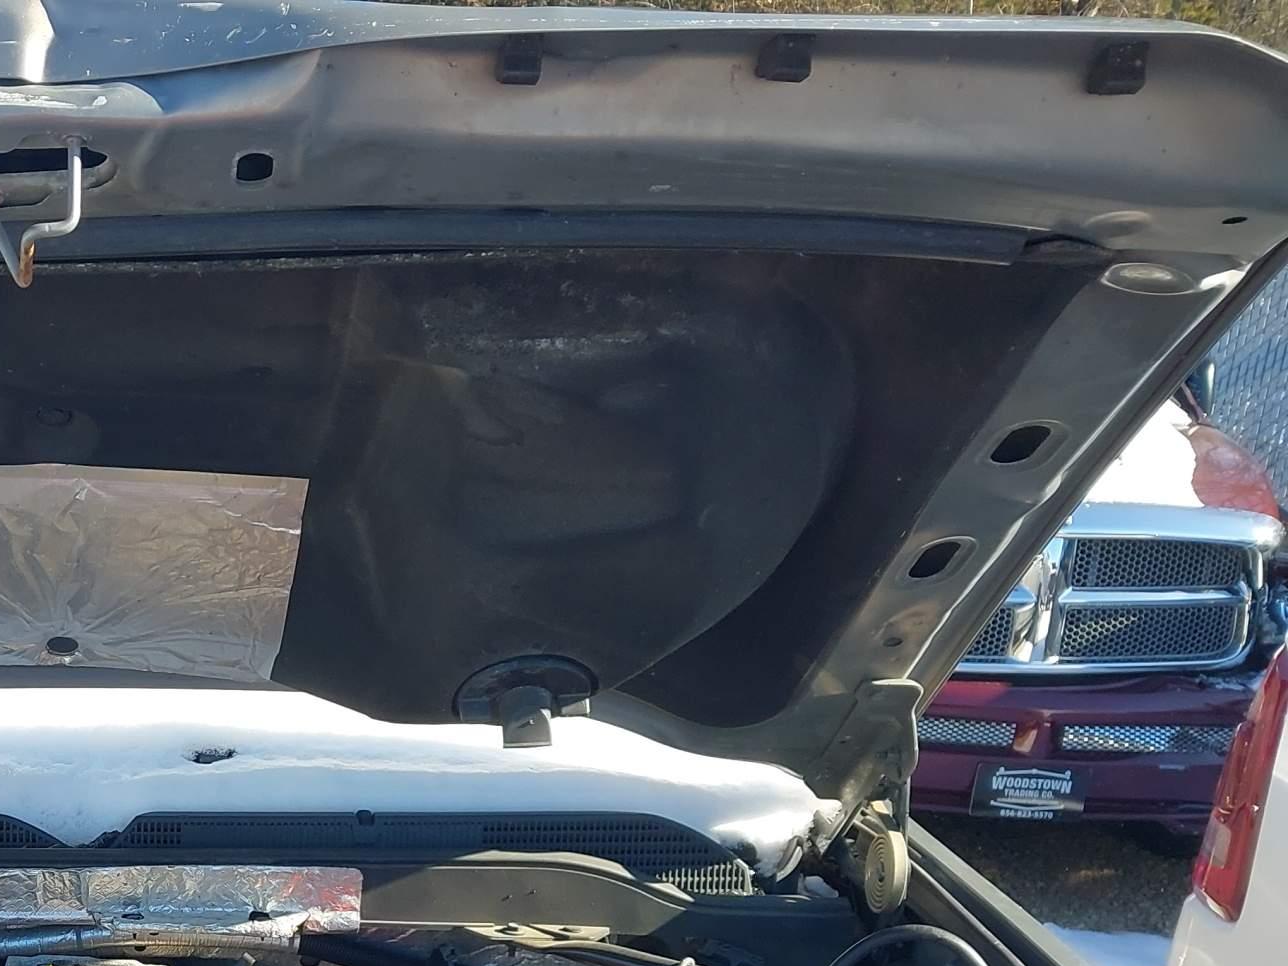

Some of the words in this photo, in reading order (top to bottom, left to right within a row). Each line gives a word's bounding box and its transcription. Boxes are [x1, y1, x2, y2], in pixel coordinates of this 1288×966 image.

[992, 775, 1072, 794] WOODSTOWN
[1004, 788, 1039, 798] TRADING
[1041, 790, 1054, 799] CO.
